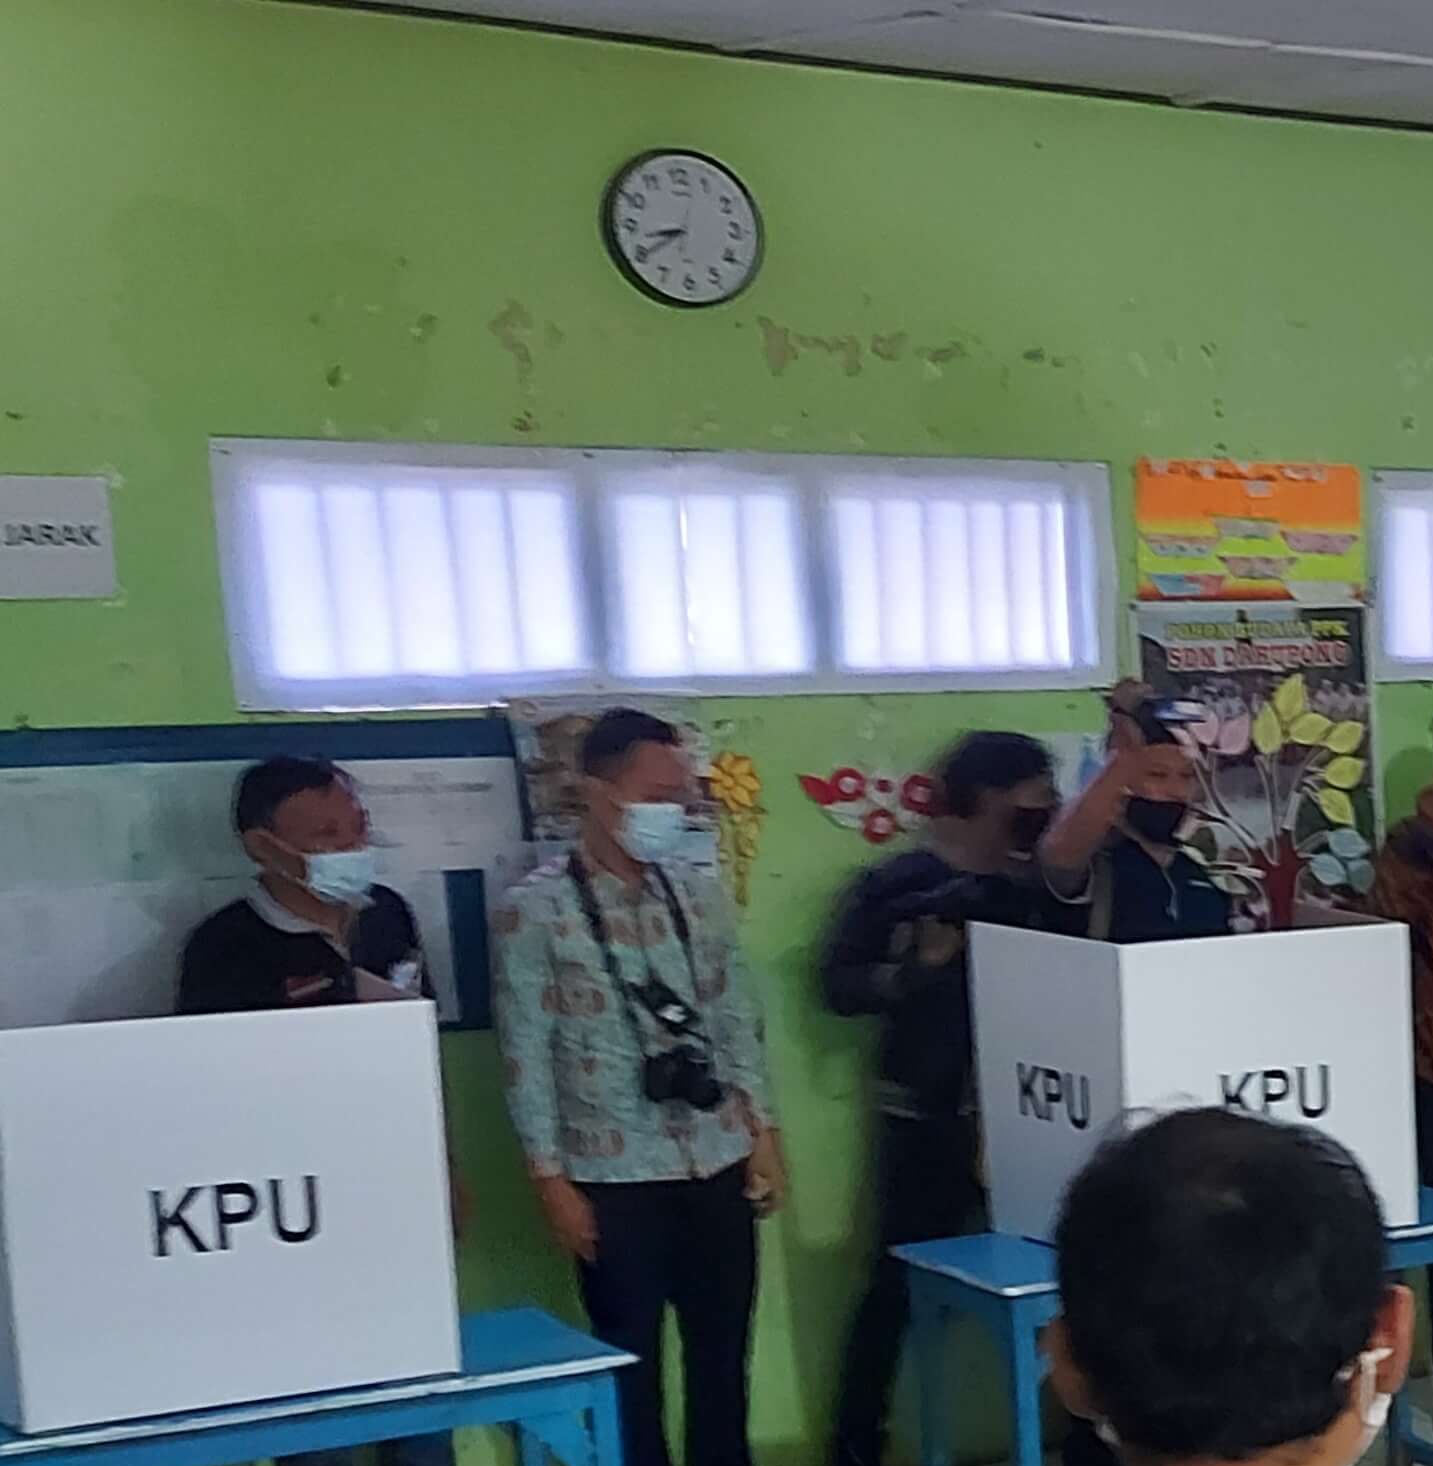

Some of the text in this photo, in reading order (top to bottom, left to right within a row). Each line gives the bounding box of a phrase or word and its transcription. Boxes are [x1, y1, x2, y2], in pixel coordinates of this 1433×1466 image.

[3, 522, 102, 547] JARAK
[1016, 1061, 1090, 1130] KPU
[1219, 1064, 1331, 1119] KPU
[148, 1175, 321, 1258] KPU
